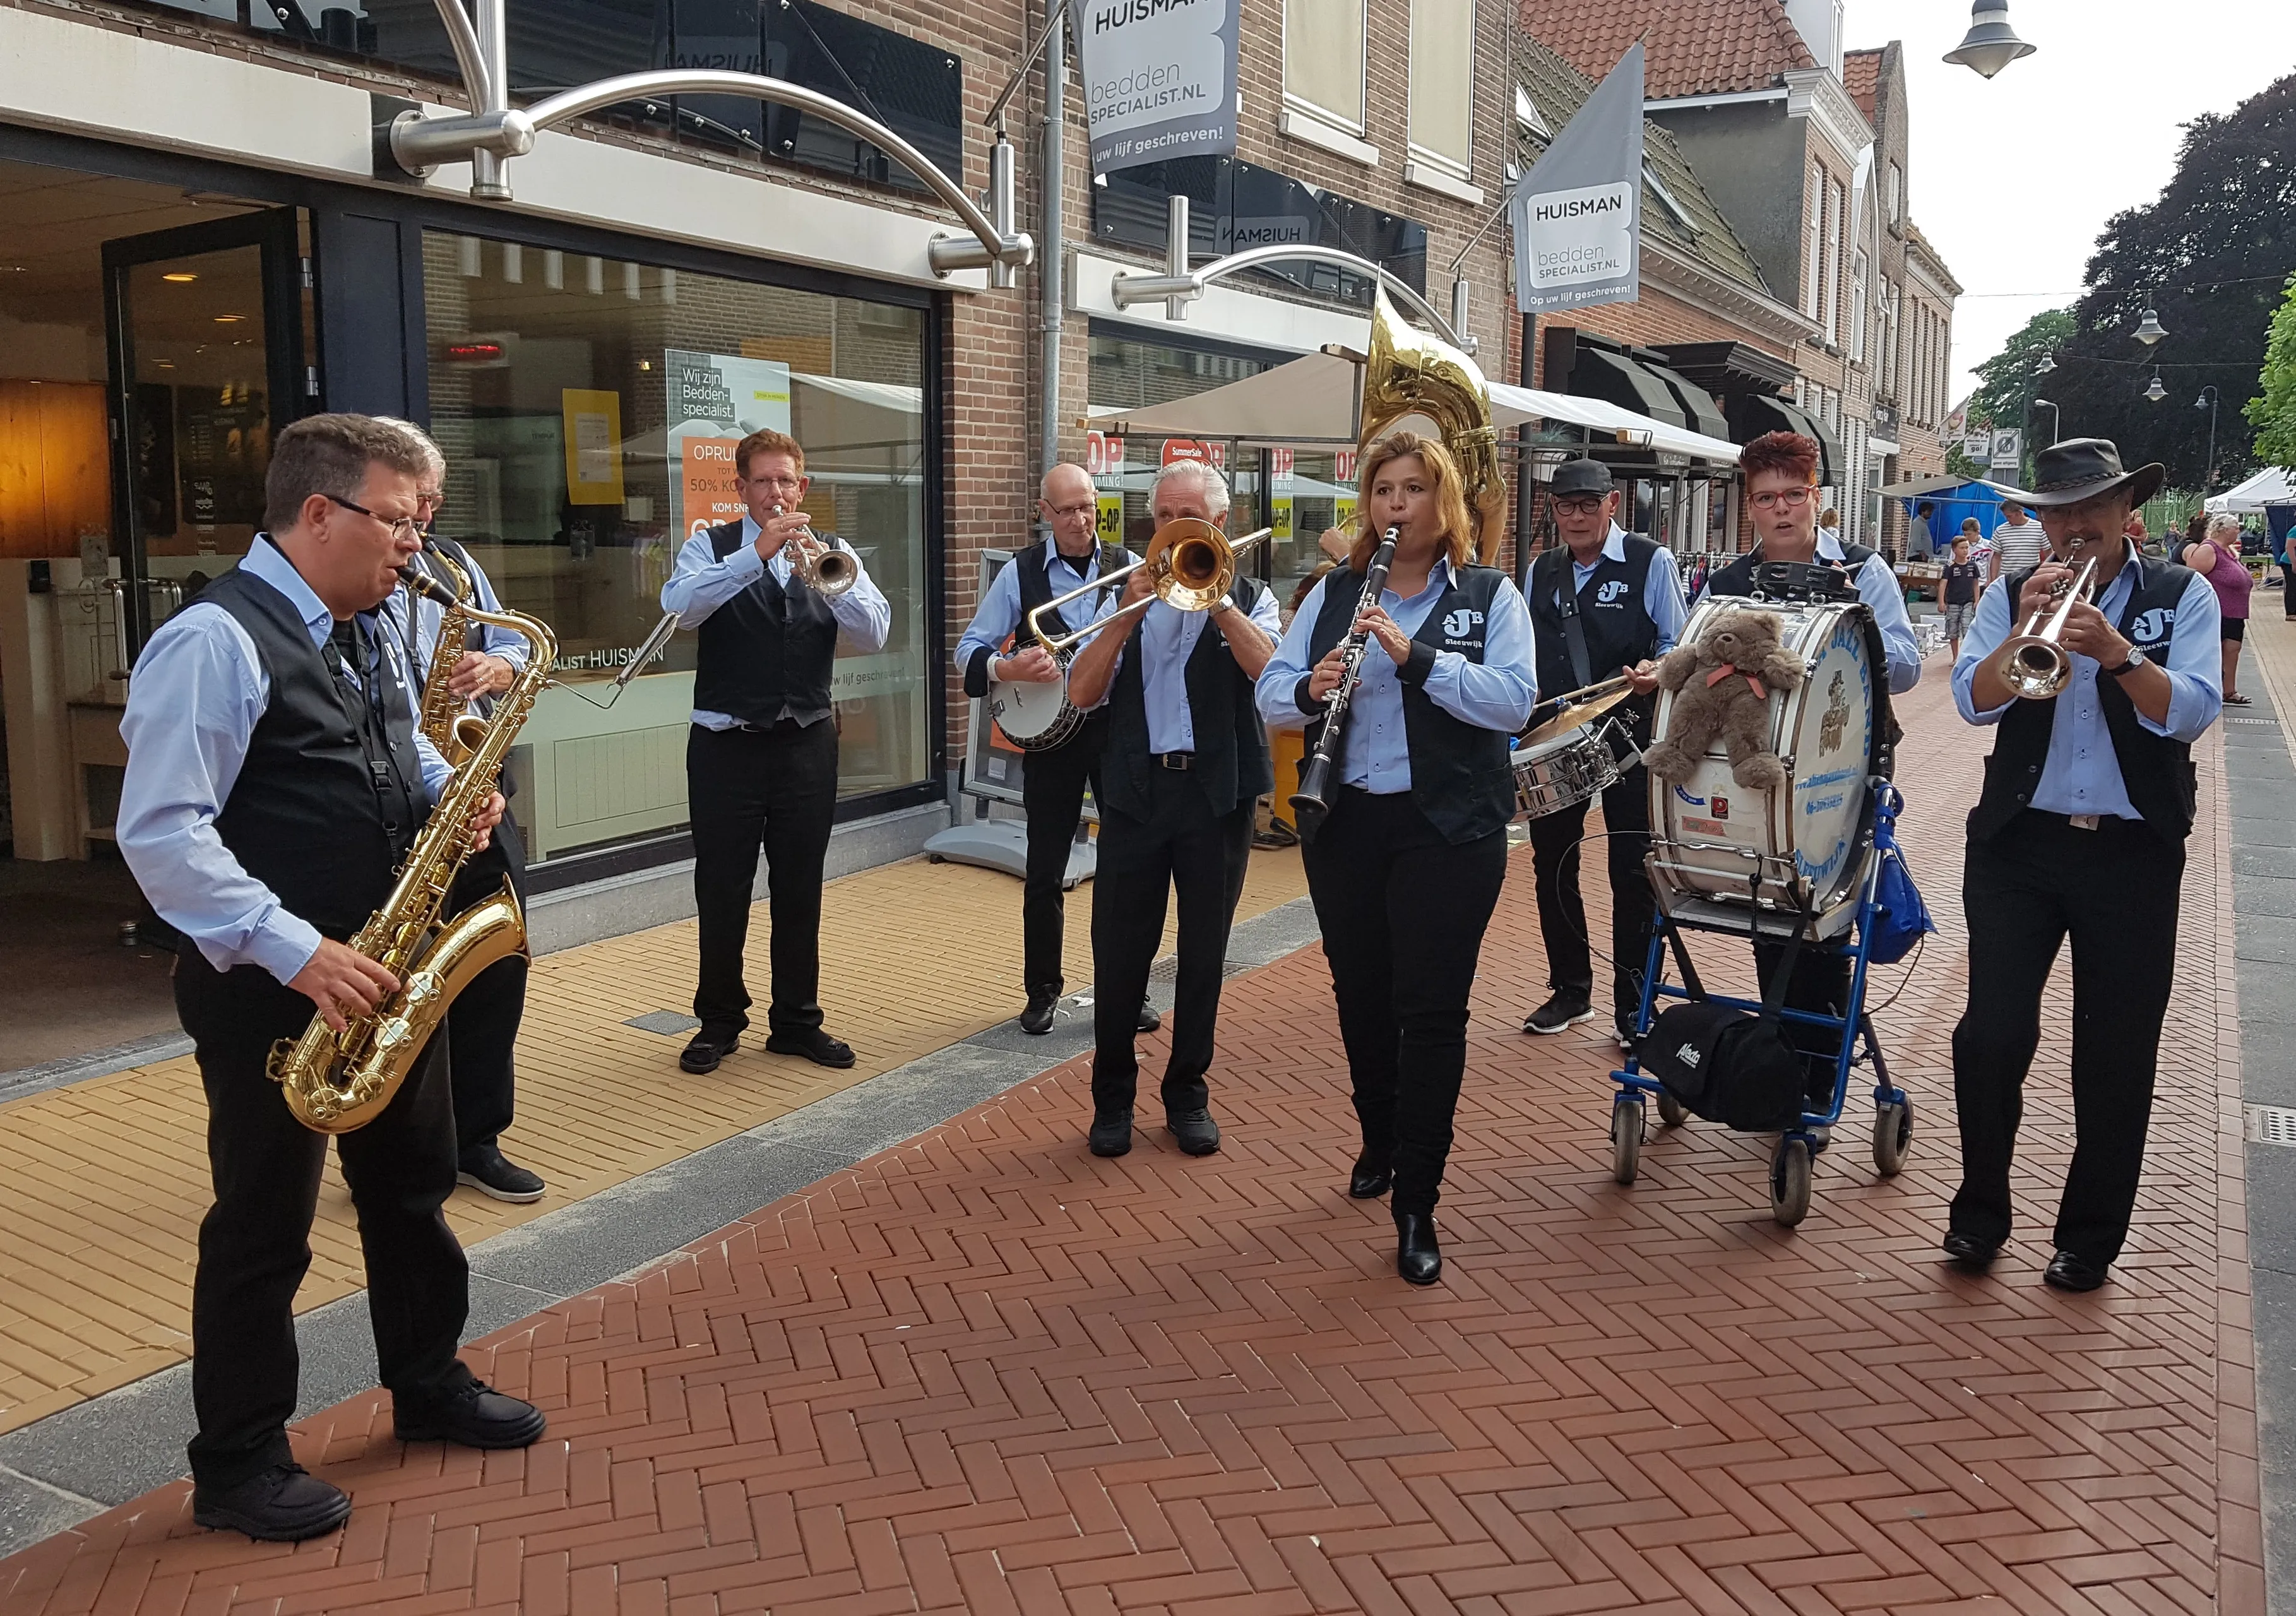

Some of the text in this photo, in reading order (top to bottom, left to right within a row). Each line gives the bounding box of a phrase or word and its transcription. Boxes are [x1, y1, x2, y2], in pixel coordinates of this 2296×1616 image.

[1095, 0, 1207, 34] HUISM
[1091, 62, 1180, 104] bedden
[1090, 83, 1206, 124] SPECIALIST.NL
[1096, 126, 1223, 163] uw lijf geschreven!
[1536, 194, 1622, 221] HUISMAN
[1538, 246, 1604, 266] bedden
[1539, 259, 1620, 278] SPECIALIST.NL
[1530, 284, 1631, 306] Op uw lijf geschreven!
[682, 367, 721, 386] Wij zijn
[683, 384, 729, 401] Bedden-
[682, 402, 734, 417] specialist.
[694, 445, 736, 461] OPRUI
[1087, 432, 1122, 475] OP
[691, 478, 718, 492] 50%
[1273, 480, 1293, 490] UIMING!
[712, 502, 732, 513] KOM
[1096, 508, 1119, 534] P=OP
[1445, 638, 1482, 648] Sleeuwijk
[1831, 625, 1860, 662] JAZZ
[2138, 641, 2171, 652] Sleeuw
[549, 646, 663, 671] ALIST HUISMN
[843, 672, 854, 686] lijf
